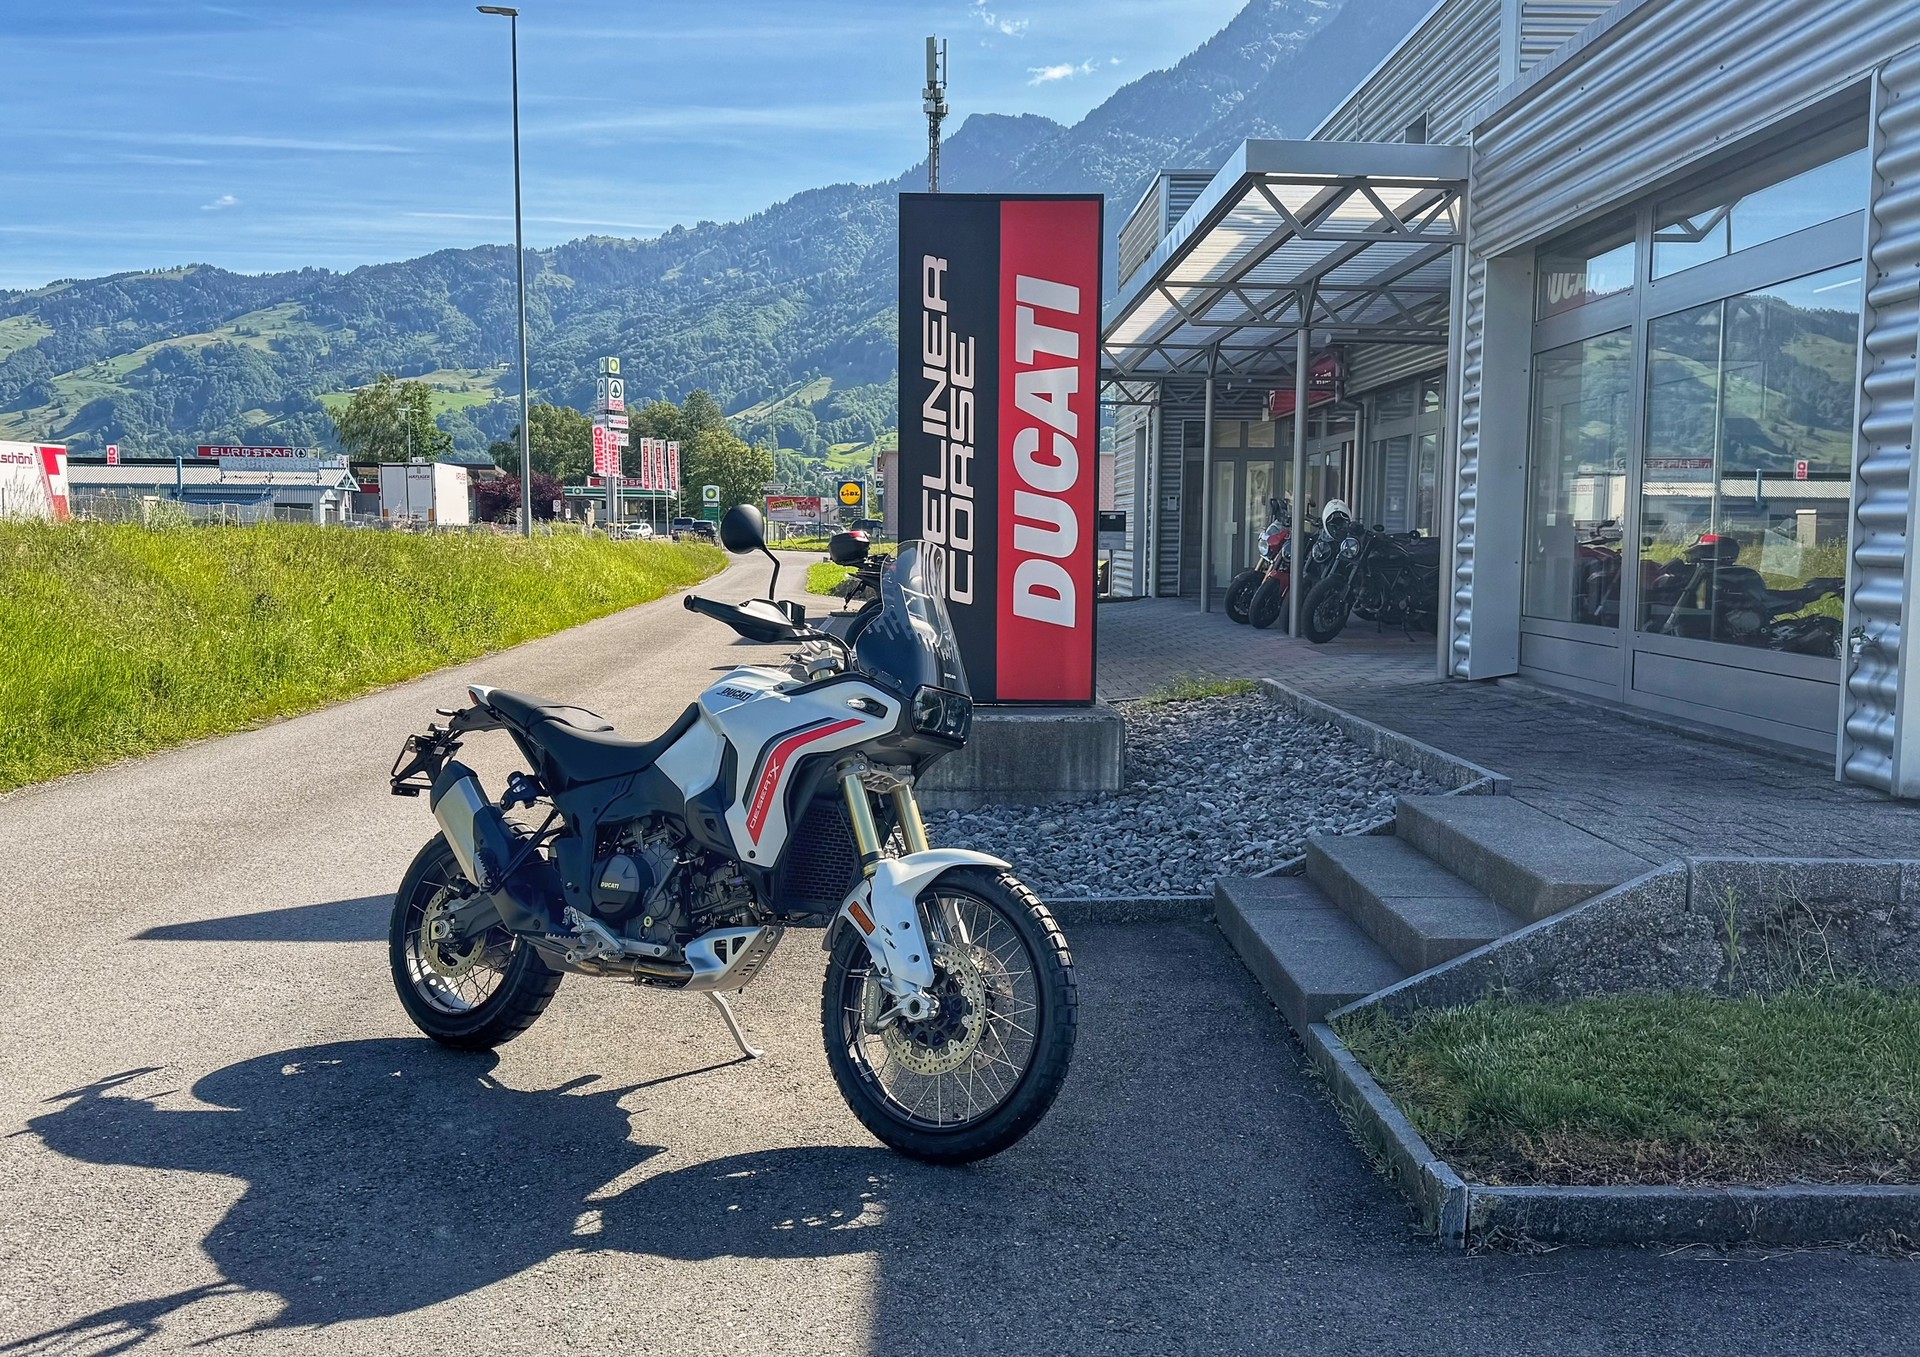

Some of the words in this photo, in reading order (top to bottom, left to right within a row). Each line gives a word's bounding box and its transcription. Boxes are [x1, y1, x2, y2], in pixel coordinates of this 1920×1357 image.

[210, 447, 293, 457] EUROSPAR
[1013, 274, 1080, 629] DUCATI
[949, 332, 976, 605] CORSE
[721, 687, 754, 700] DUCATI
[600, 881, 620, 890] DUCATI
[867, 985, 876, 1019] brembo
